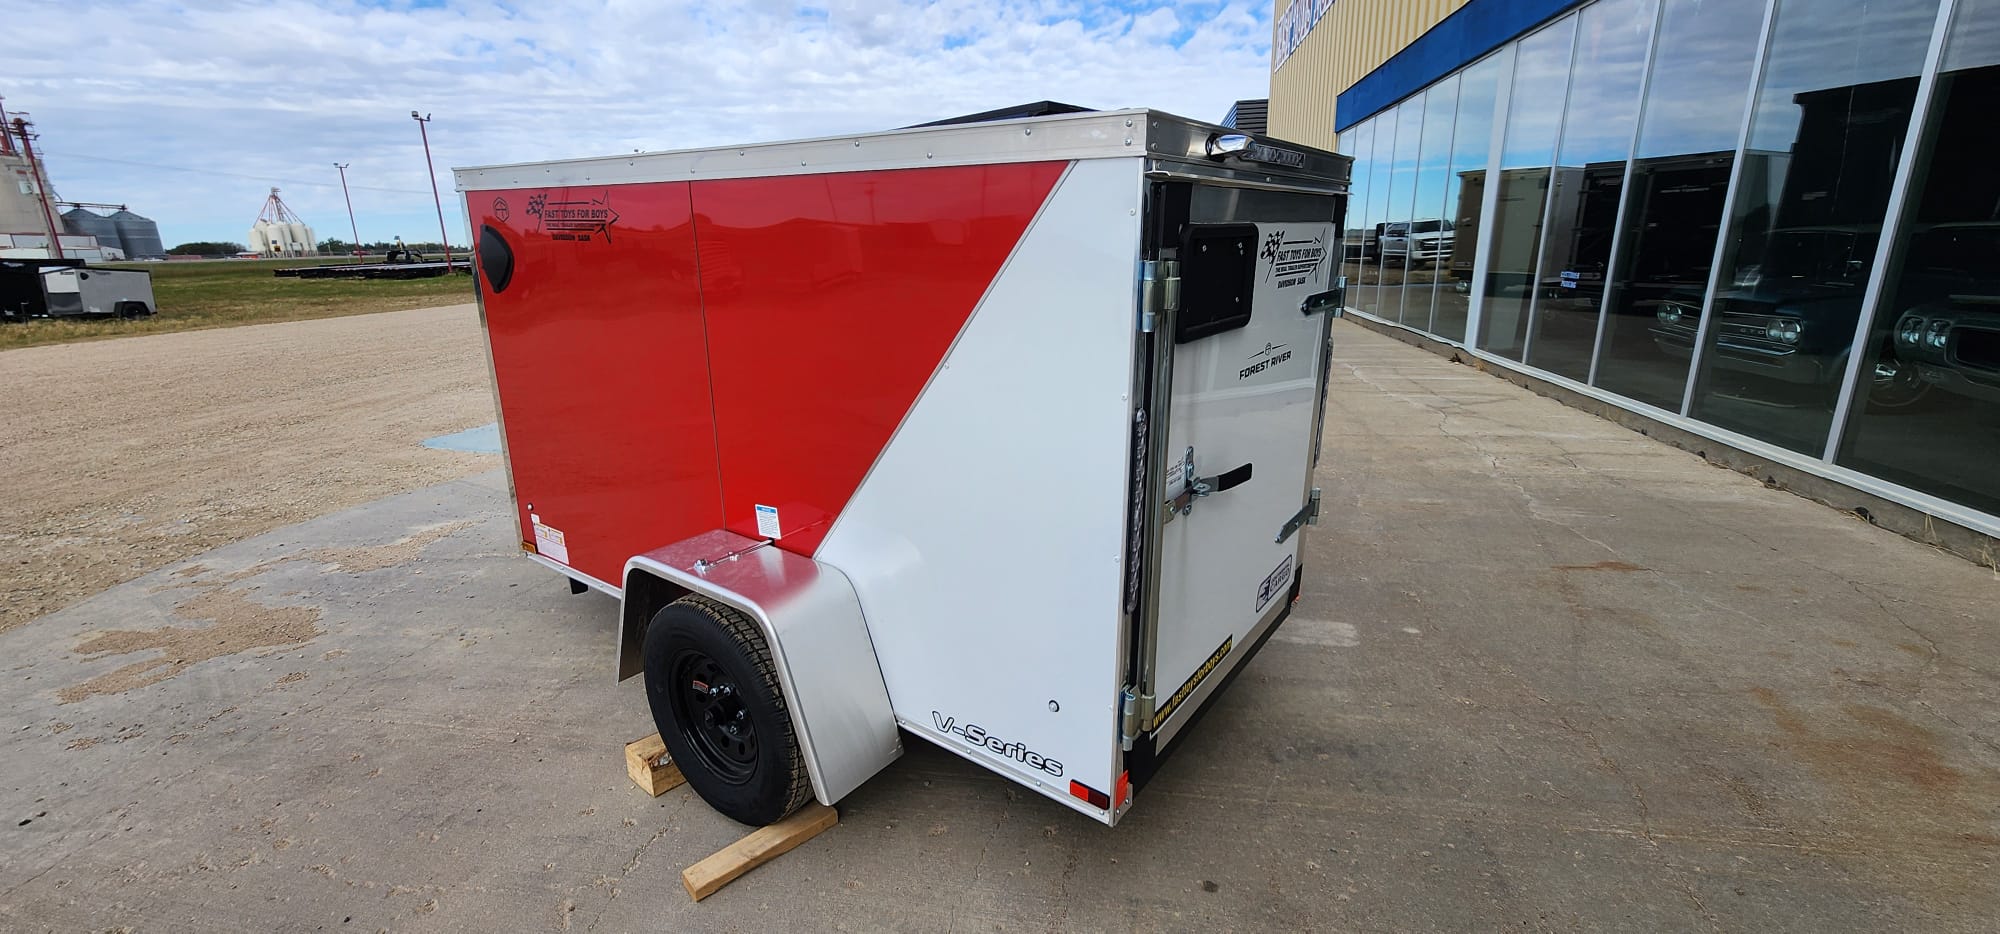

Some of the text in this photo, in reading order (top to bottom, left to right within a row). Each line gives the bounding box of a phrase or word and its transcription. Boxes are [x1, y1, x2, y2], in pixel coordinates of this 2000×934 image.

[545, 208, 609, 218] FAST TOYS FOR BOYS
[1276, 247, 1322, 262] FAST TOYS FOR BOYS
[1239, 350, 1292, 380] FOREST RIVER
[1152, 639, 1233, 729] www.fasttoysforboys.com
[932, 710, 1064, 778] V-Series
